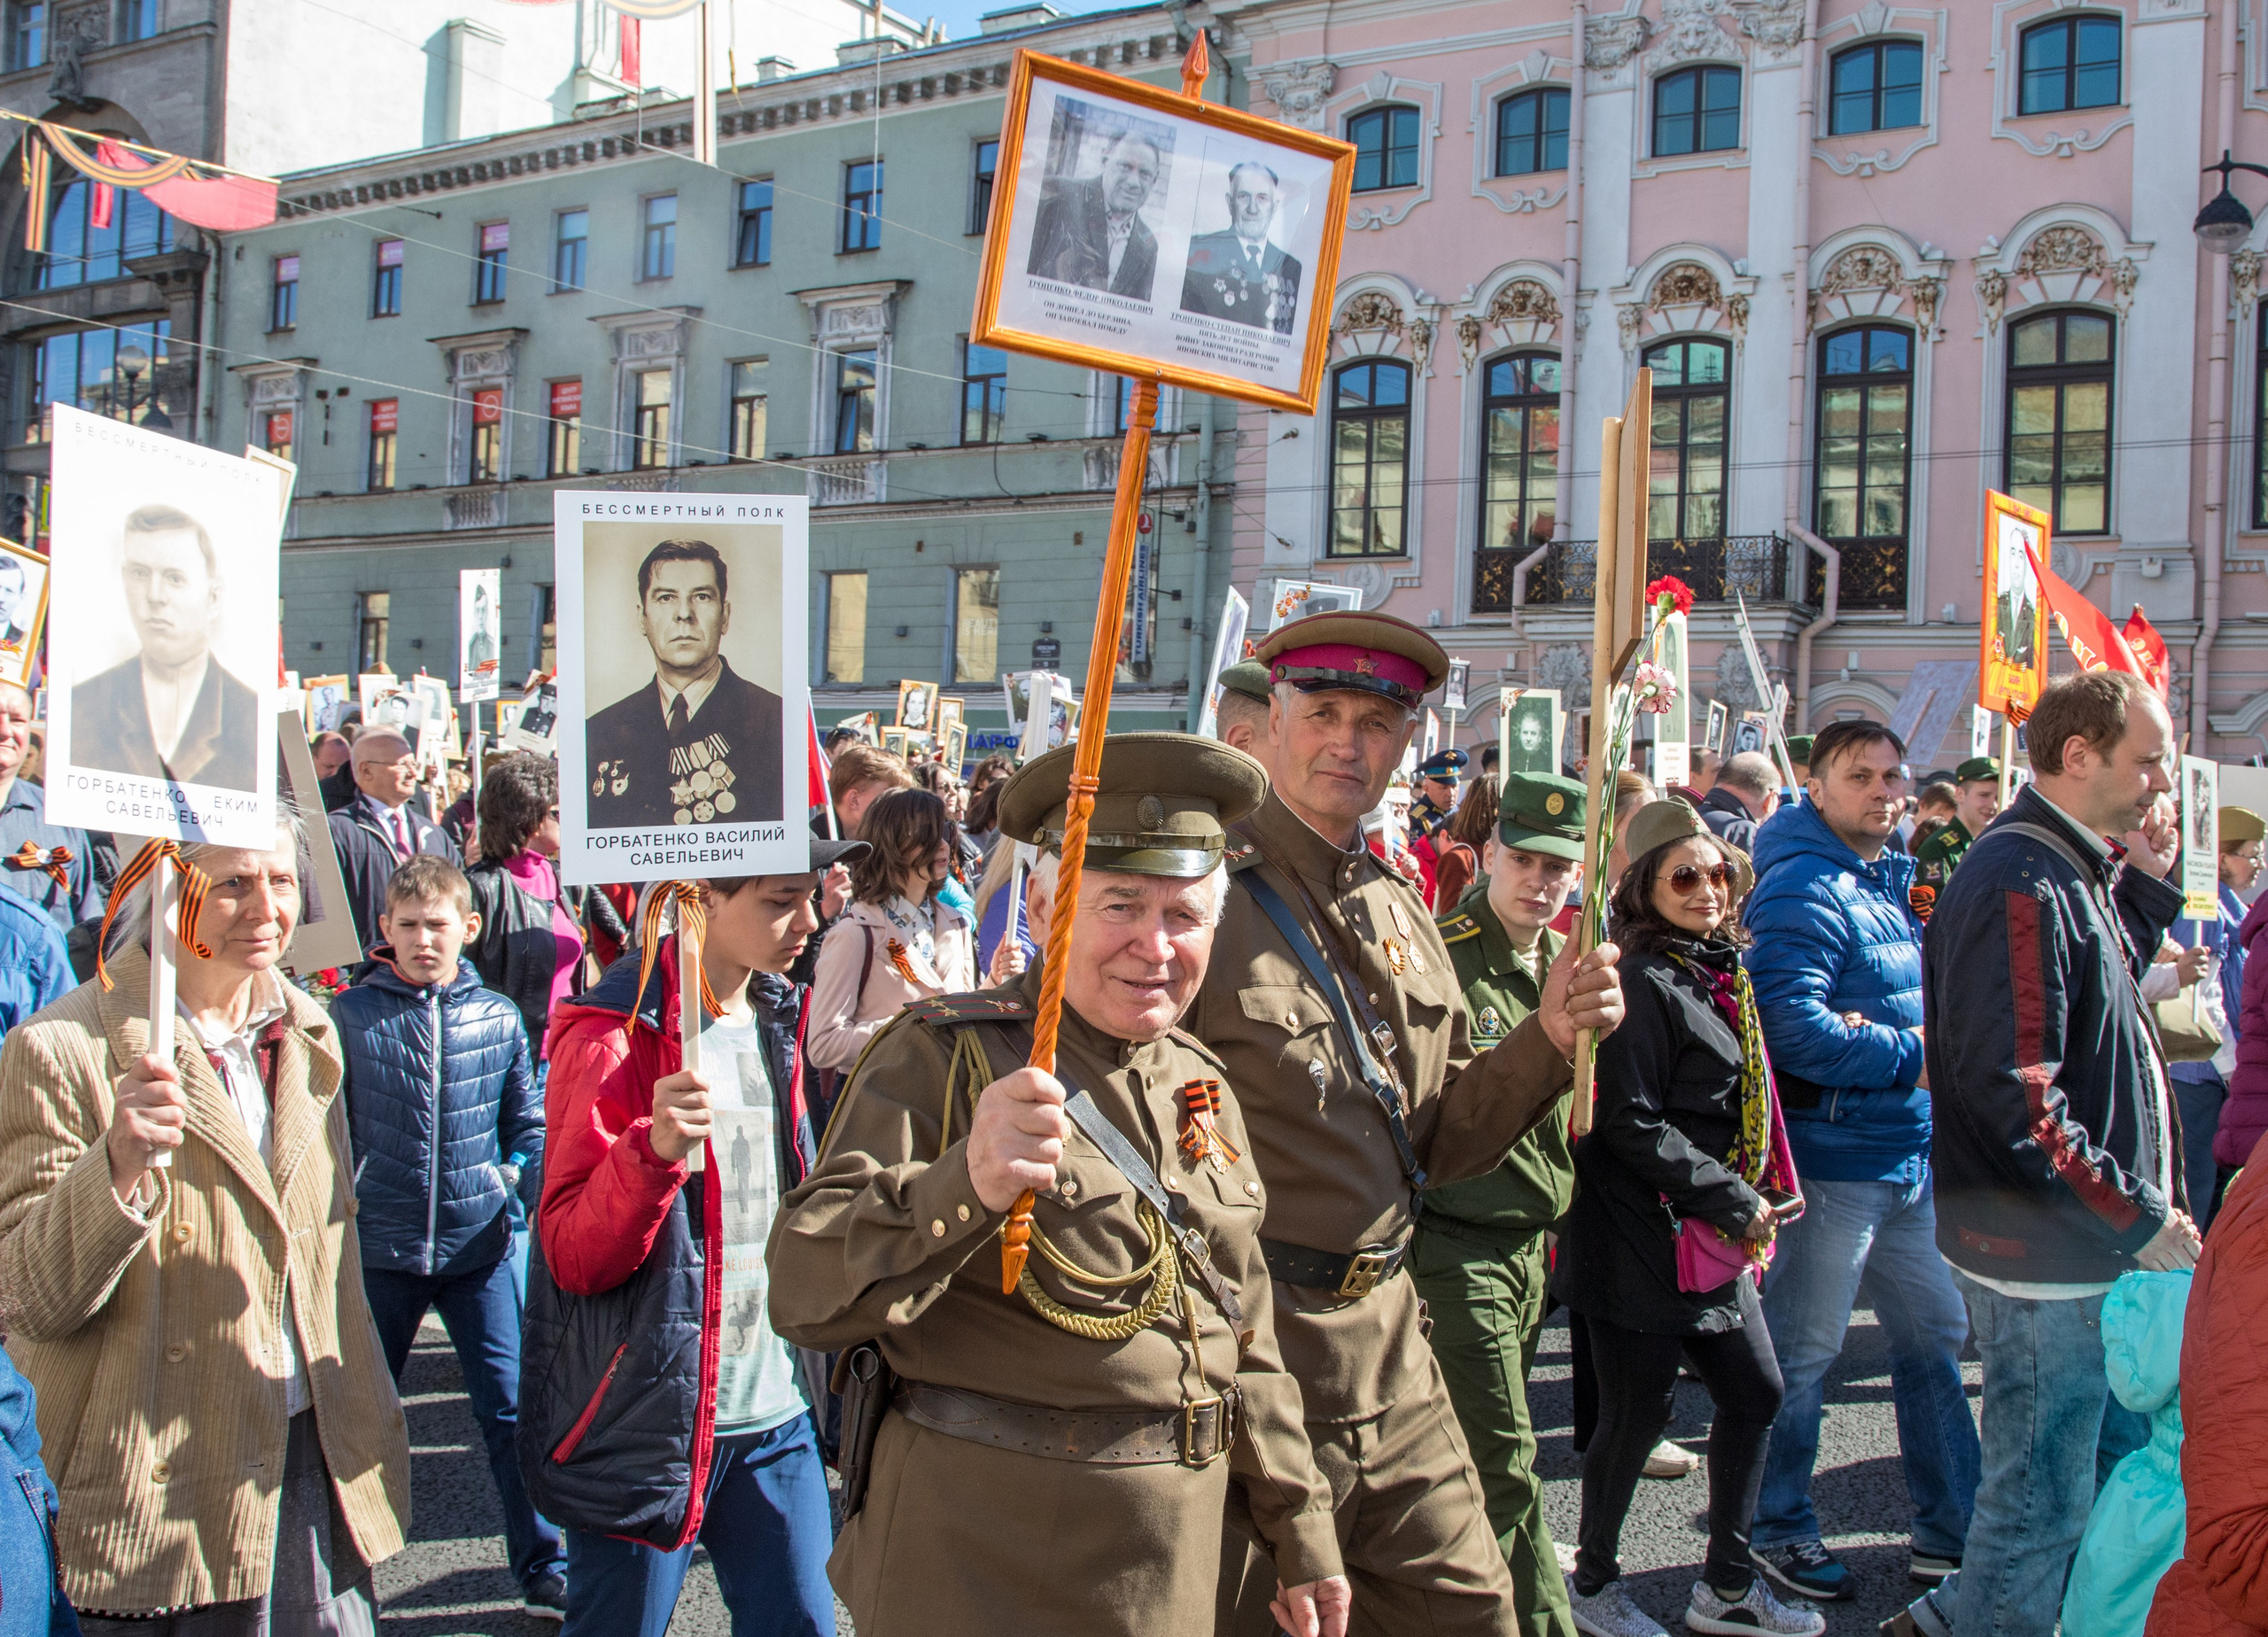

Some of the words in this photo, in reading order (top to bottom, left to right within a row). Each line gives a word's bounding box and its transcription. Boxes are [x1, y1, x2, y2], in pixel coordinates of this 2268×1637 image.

[1028, 279, 1071, 295] ТРОЦЕНКО
[1100, 296, 1153, 314] НИКОЛАЕВИЧ
[1056, 302, 1084, 314] ДОШЕЛ
[1085, 309, 1096, 318] ДО
[1058, 314, 1096, 329] ЗАВОЕВАЛ
[1098, 322, 1127, 335] ПОБЕДУ
[1170, 312, 1210, 327] ТРОЦЕНКО
[1211, 322, 1241, 335] СТЕПАН
[1242, 330, 1291, 346] НИКОЛАЕВИЧ
[1176, 334, 1199, 345] ВОЙНУ
[1202, 340, 1238, 354] ЗАКОНЧИЛ
[1239, 349, 1279, 363] РАЗГРОМИВ
[1177, 345, 1216, 359] ЯПОНСКИХ
[75, 422, 207, 469] БЕССМЕРТНЫЙ
[221, 465, 262, 485] ПОЛК
[582, 504, 725, 516] БЕССМЕРТНЫЙ
[737, 507, 784, 517] ПОЛК
[1138, 545, 1146, 601] AIRLINES
[1135, 602, 1144, 656] TURKISH
[67, 775, 185, 803] ГОРБАТЕНКО
[214, 796, 258, 813] ЕКИМ
[106, 800, 223, 827] САВЕЛЬЕВИЧ
[586, 832, 699, 850] ГОРБАТЕНКО
[705, 826, 785, 844] ВАСИЛИЙ
[630, 849, 743, 865] САВЕЛЬЕВИЧ
